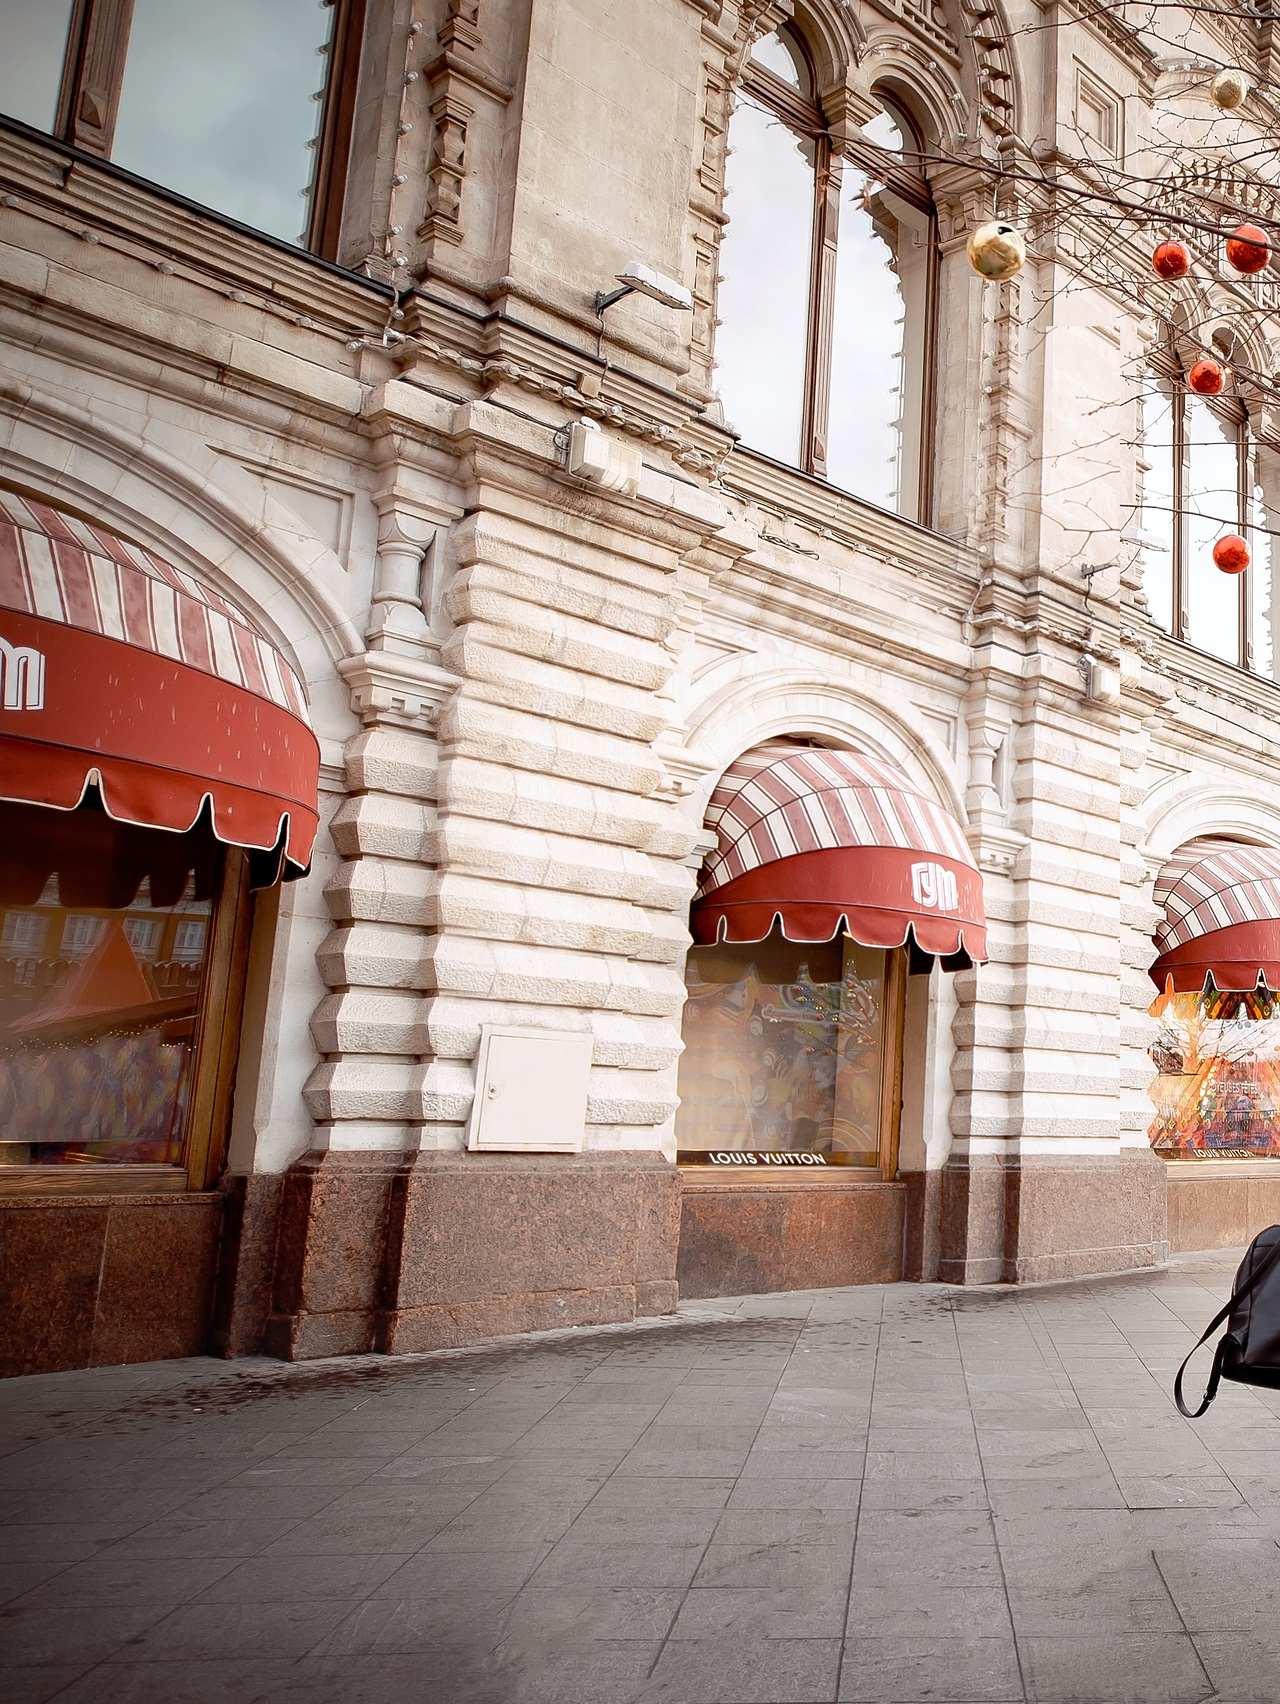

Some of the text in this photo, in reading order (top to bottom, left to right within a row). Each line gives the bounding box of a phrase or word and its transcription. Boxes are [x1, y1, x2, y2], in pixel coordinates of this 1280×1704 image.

[1206, 1081, 1240, 1093] OYEUSES
[708, 1152, 827, 1165] LOUIS VUITTON
[1193, 1149, 1220, 1158] LOUIS
